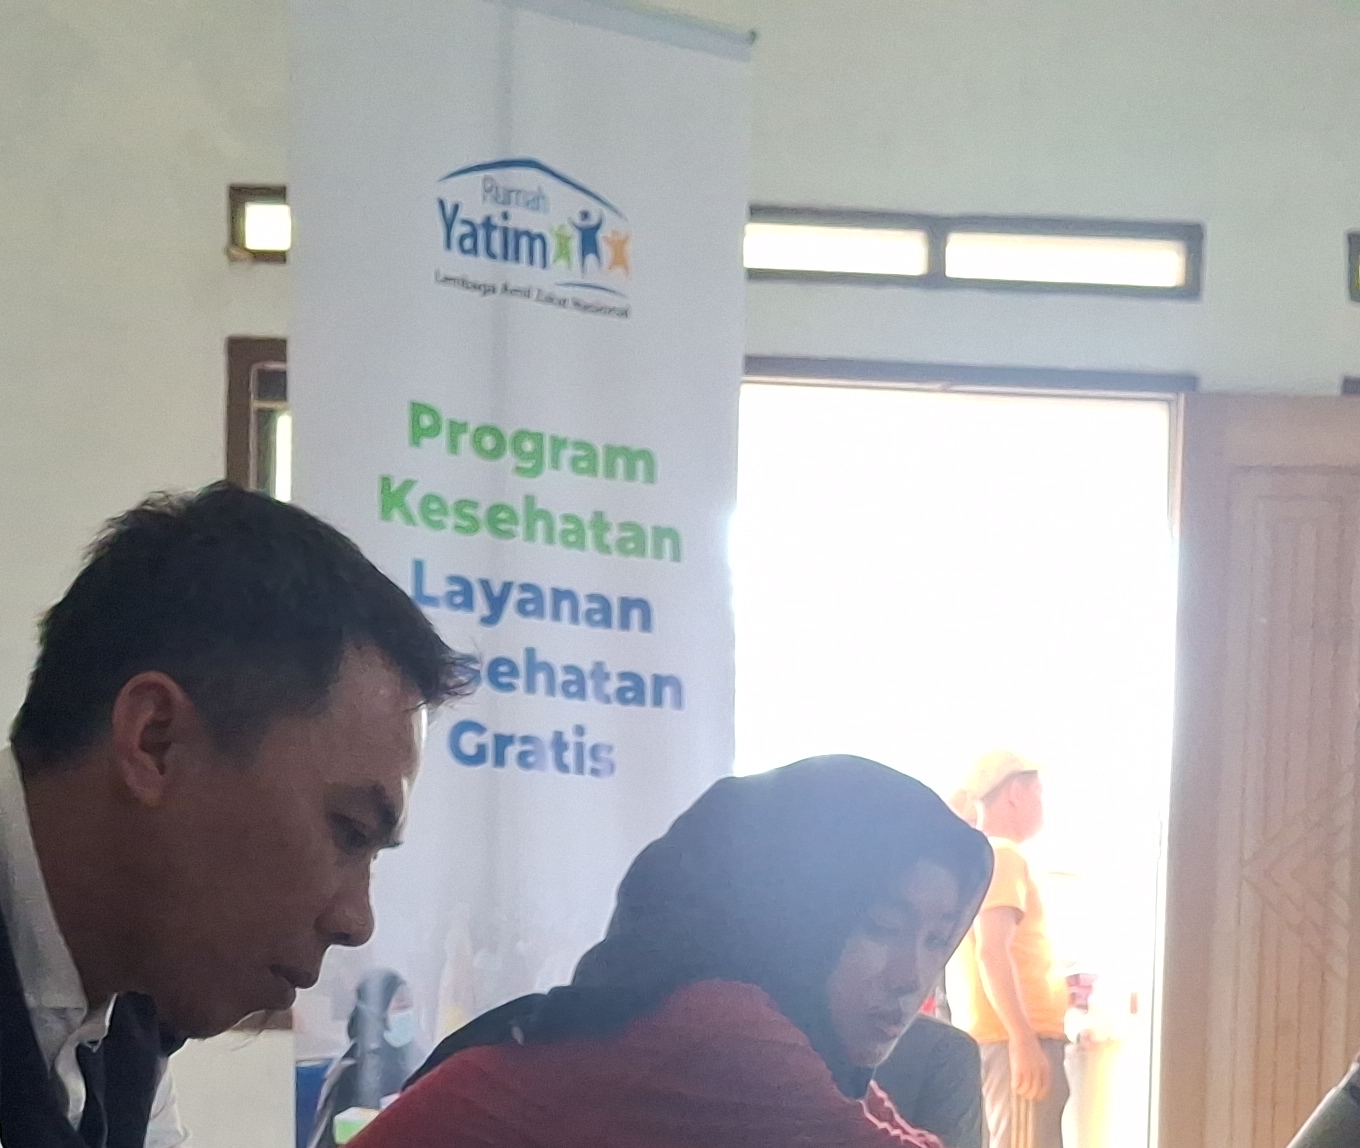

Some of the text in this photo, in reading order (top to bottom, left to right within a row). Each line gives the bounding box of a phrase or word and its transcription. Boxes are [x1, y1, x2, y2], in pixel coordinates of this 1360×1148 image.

[482, 175, 549, 214] Rumah
[437, 197, 548, 270] Yatim
[408, 401, 657, 485] Program
[377, 474, 683, 562] Kesehatan
[412, 558, 654, 634] Layanan
[450, 646, 684, 710] sehatan
[446, 718, 617, 778] Gratis
